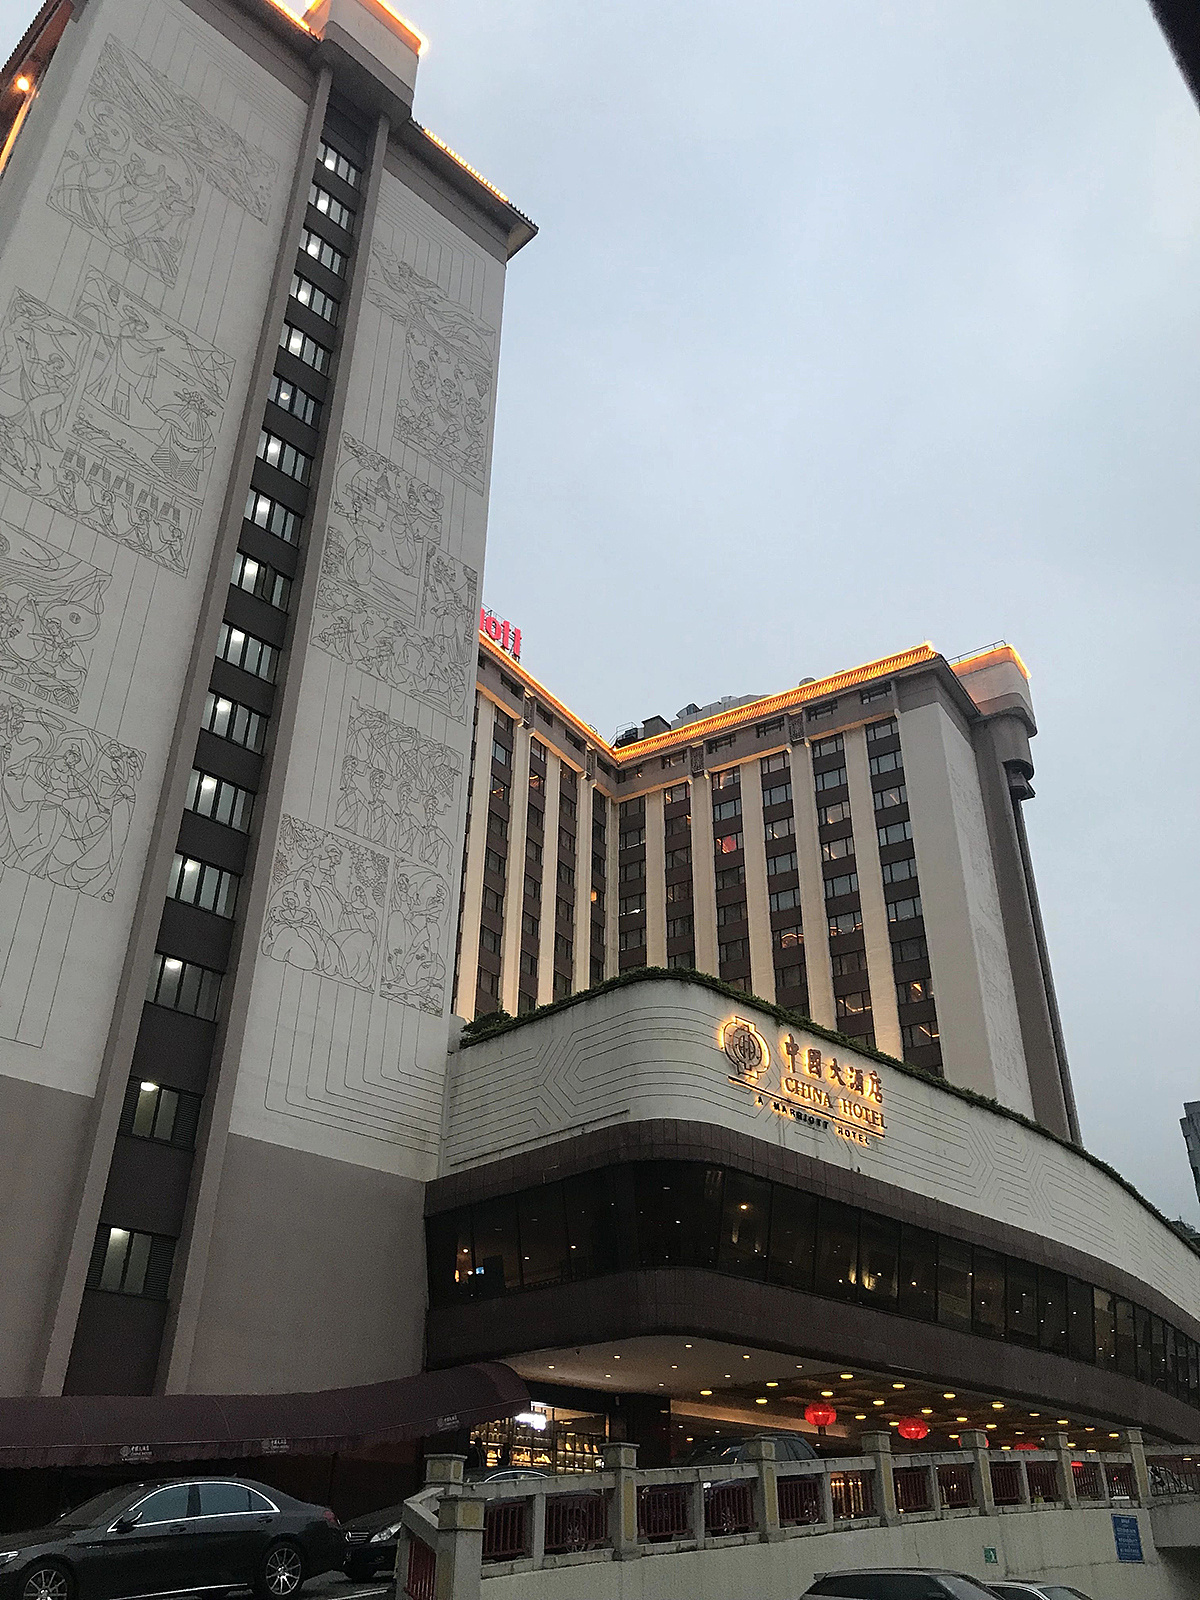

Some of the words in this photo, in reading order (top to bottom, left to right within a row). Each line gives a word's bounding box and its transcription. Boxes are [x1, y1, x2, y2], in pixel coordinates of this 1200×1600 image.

[772, 1101, 829, 1130] MARRIOTT
[837, 1126, 870, 1145] HOTEL
[784, 1077, 834, 1108] CHINA
[841, 1098, 888, 1129] HOTEL
